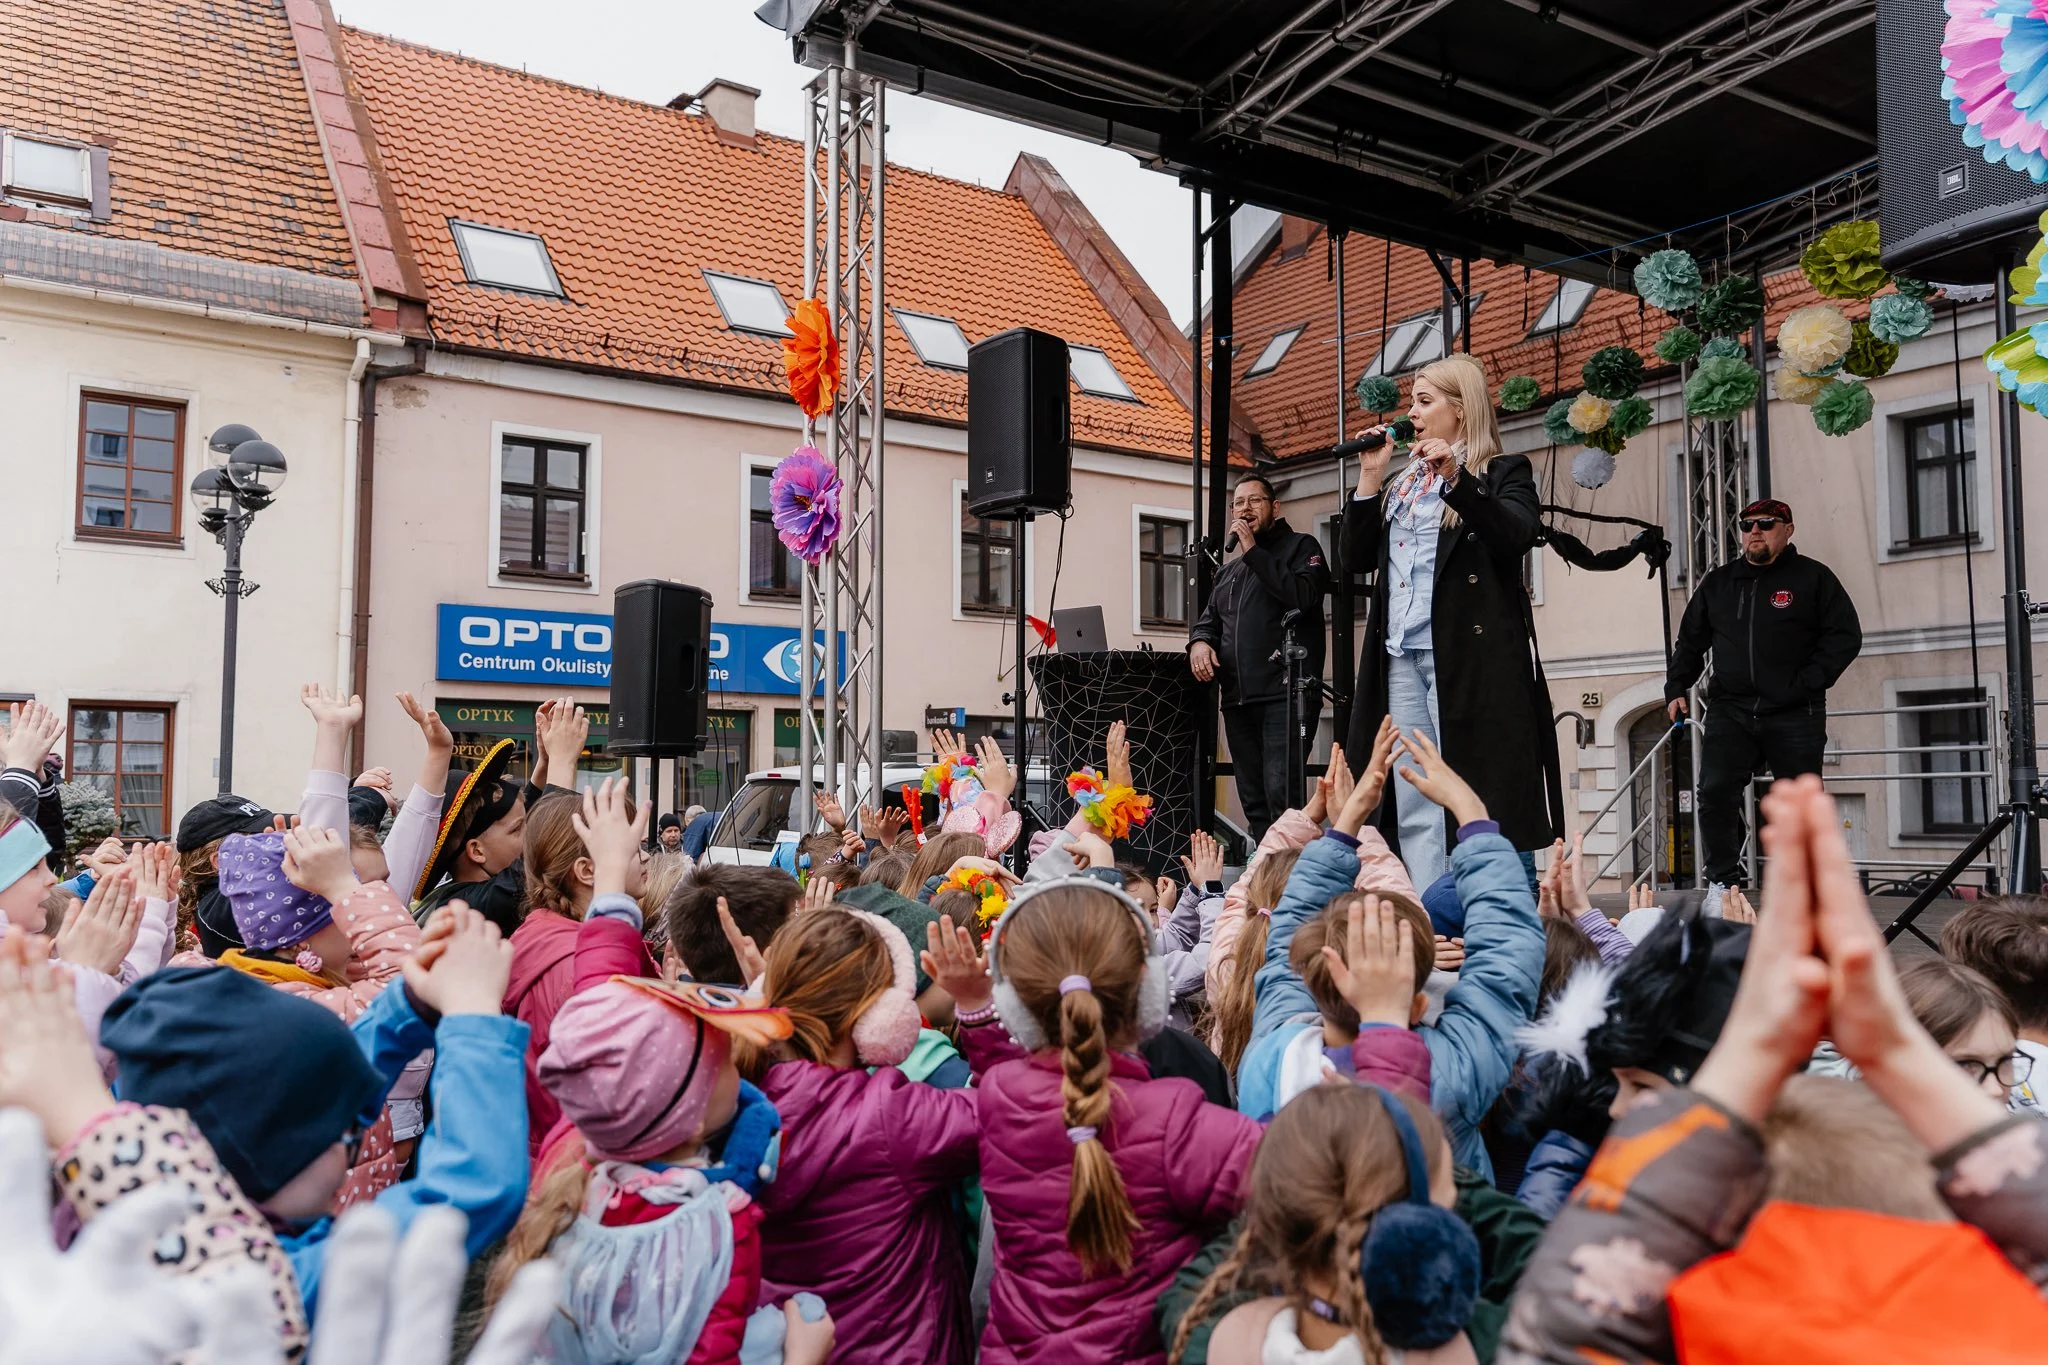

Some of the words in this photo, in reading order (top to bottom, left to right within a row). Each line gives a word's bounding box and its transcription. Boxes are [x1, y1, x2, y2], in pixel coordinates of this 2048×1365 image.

[459, 616, 612, 653] OPTO
[459, 652, 536, 671] Centrum
[541, 656, 612, 678] Okulisty
[1582, 692, 1599, 705] 25
[456, 707, 515, 722] OPTYK
[706, 716, 736, 729] TYK
